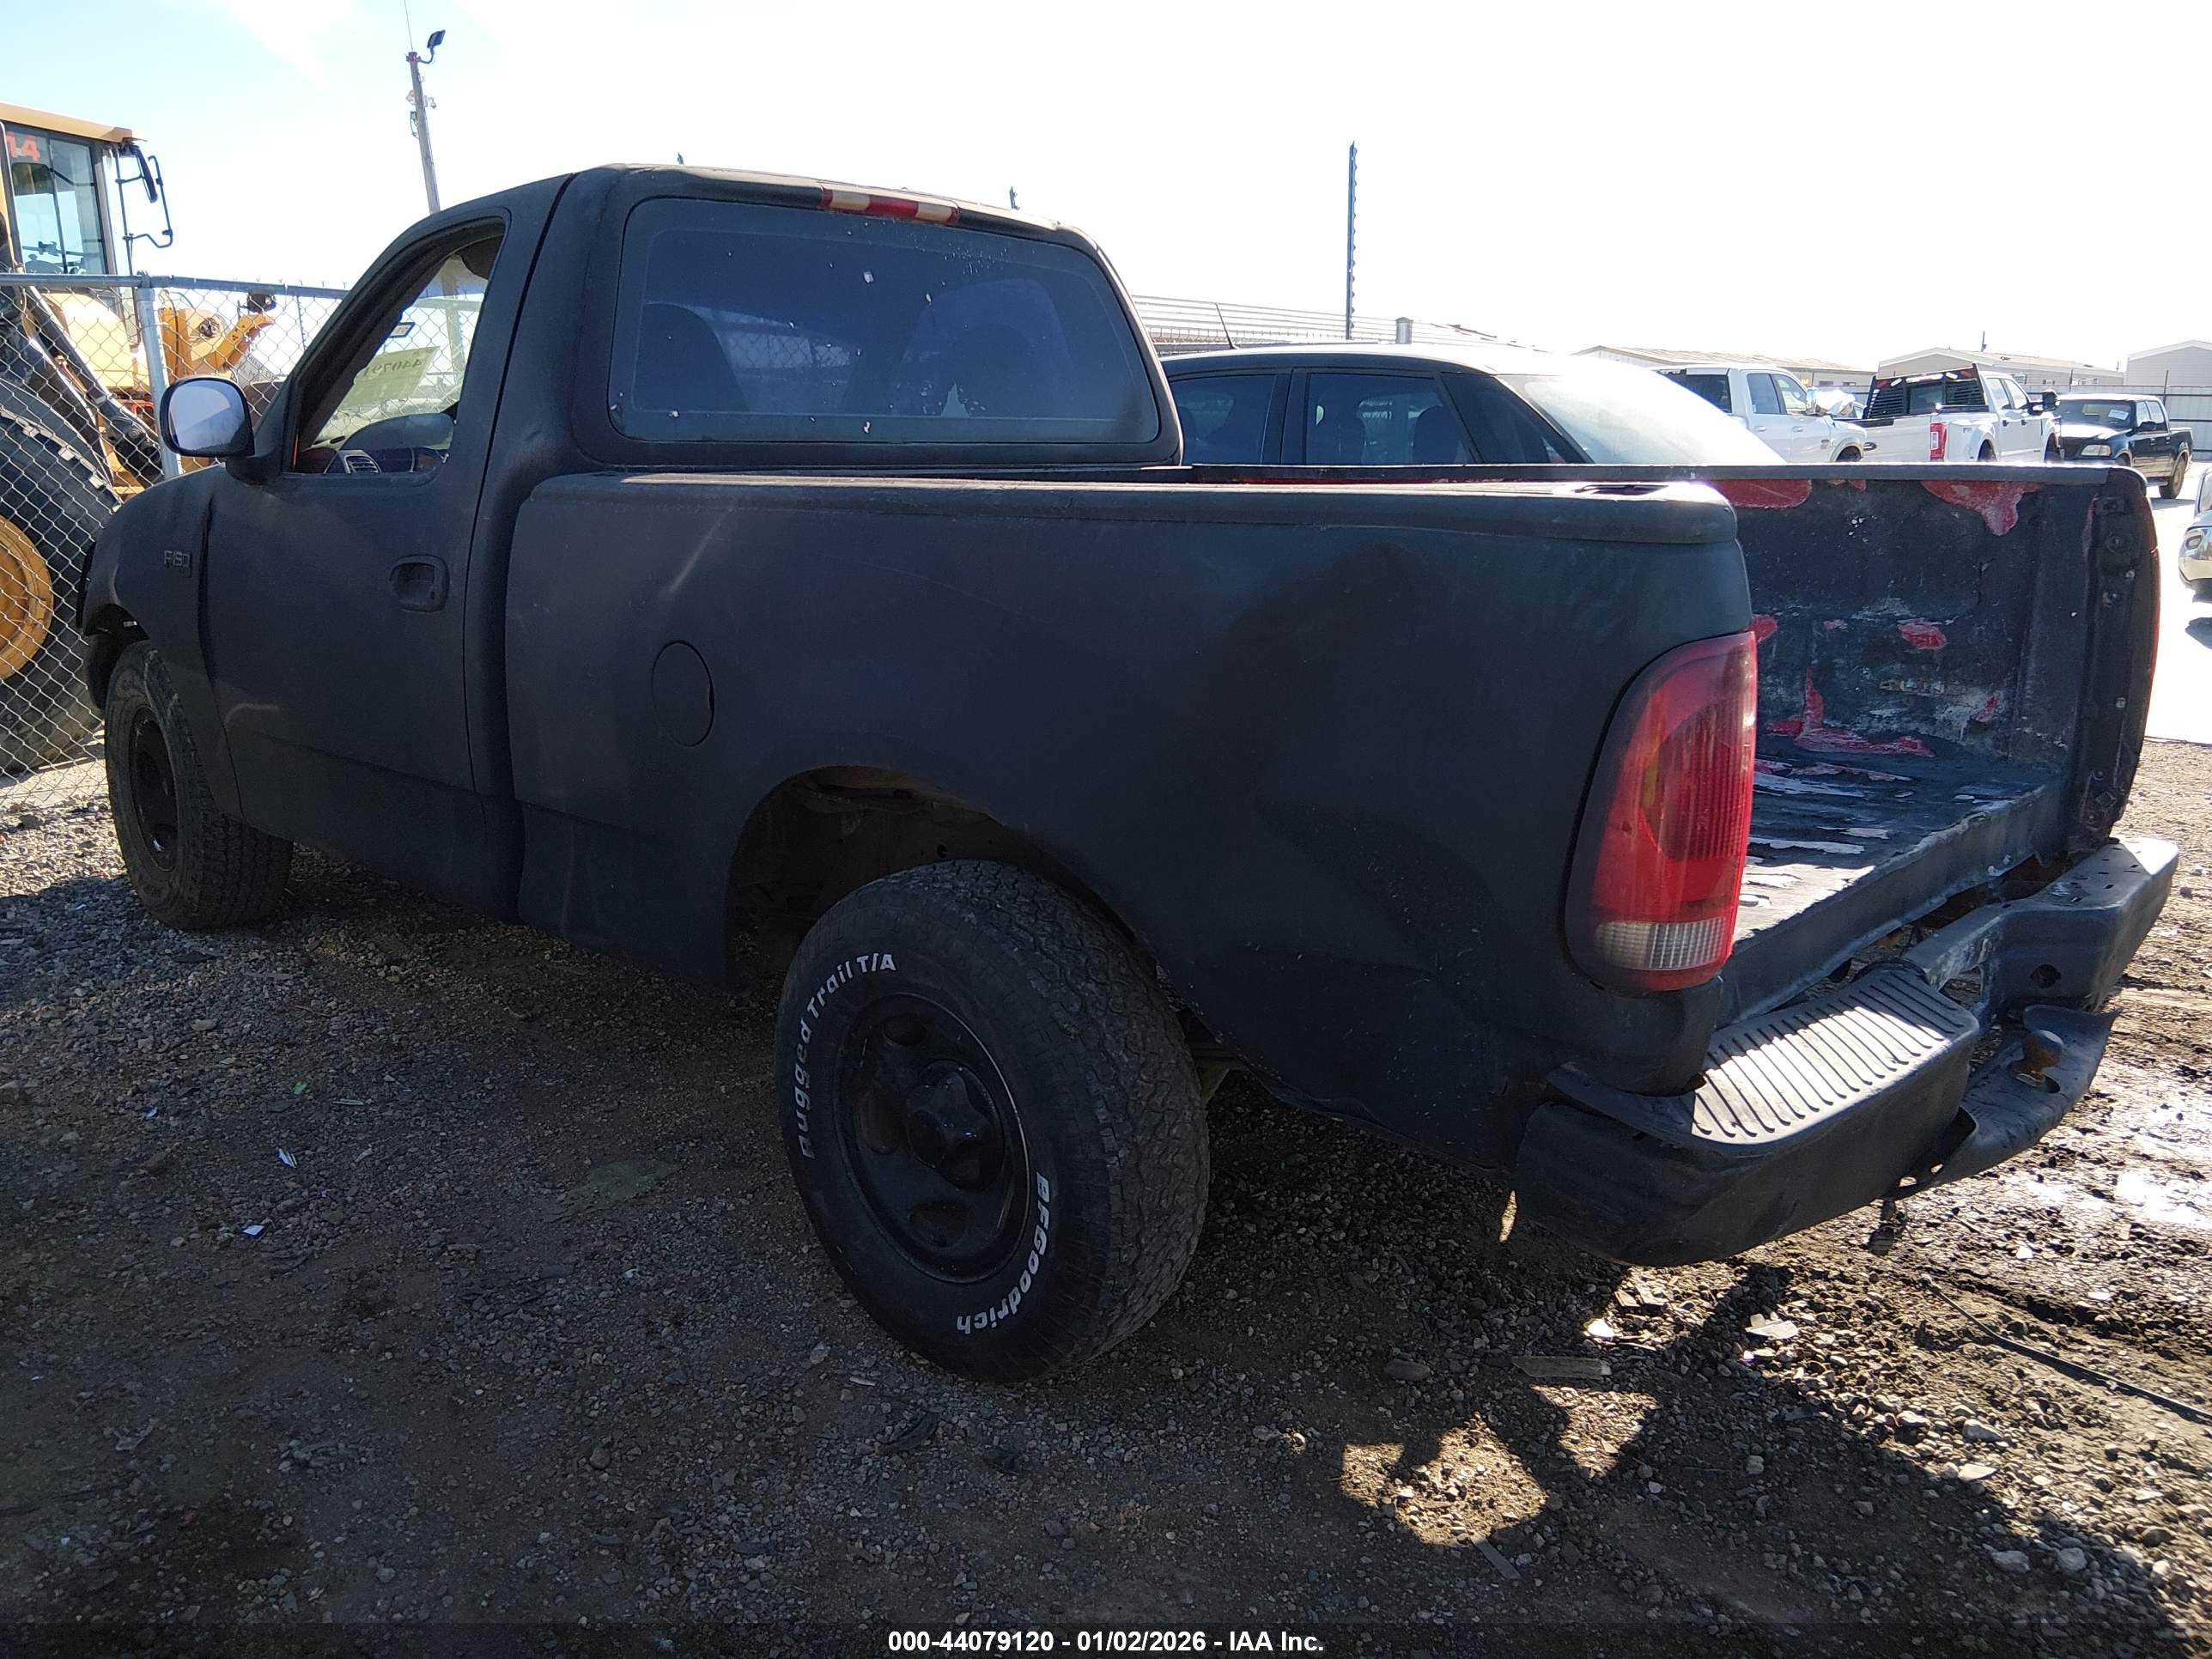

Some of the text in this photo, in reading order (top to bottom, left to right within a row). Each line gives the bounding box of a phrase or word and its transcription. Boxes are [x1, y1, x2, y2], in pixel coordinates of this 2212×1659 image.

[806, 961, 854, 1019] Trail
[856, 952, 896, 973] T/A
[957, 1171, 1050, 1334] BFGoodrich
